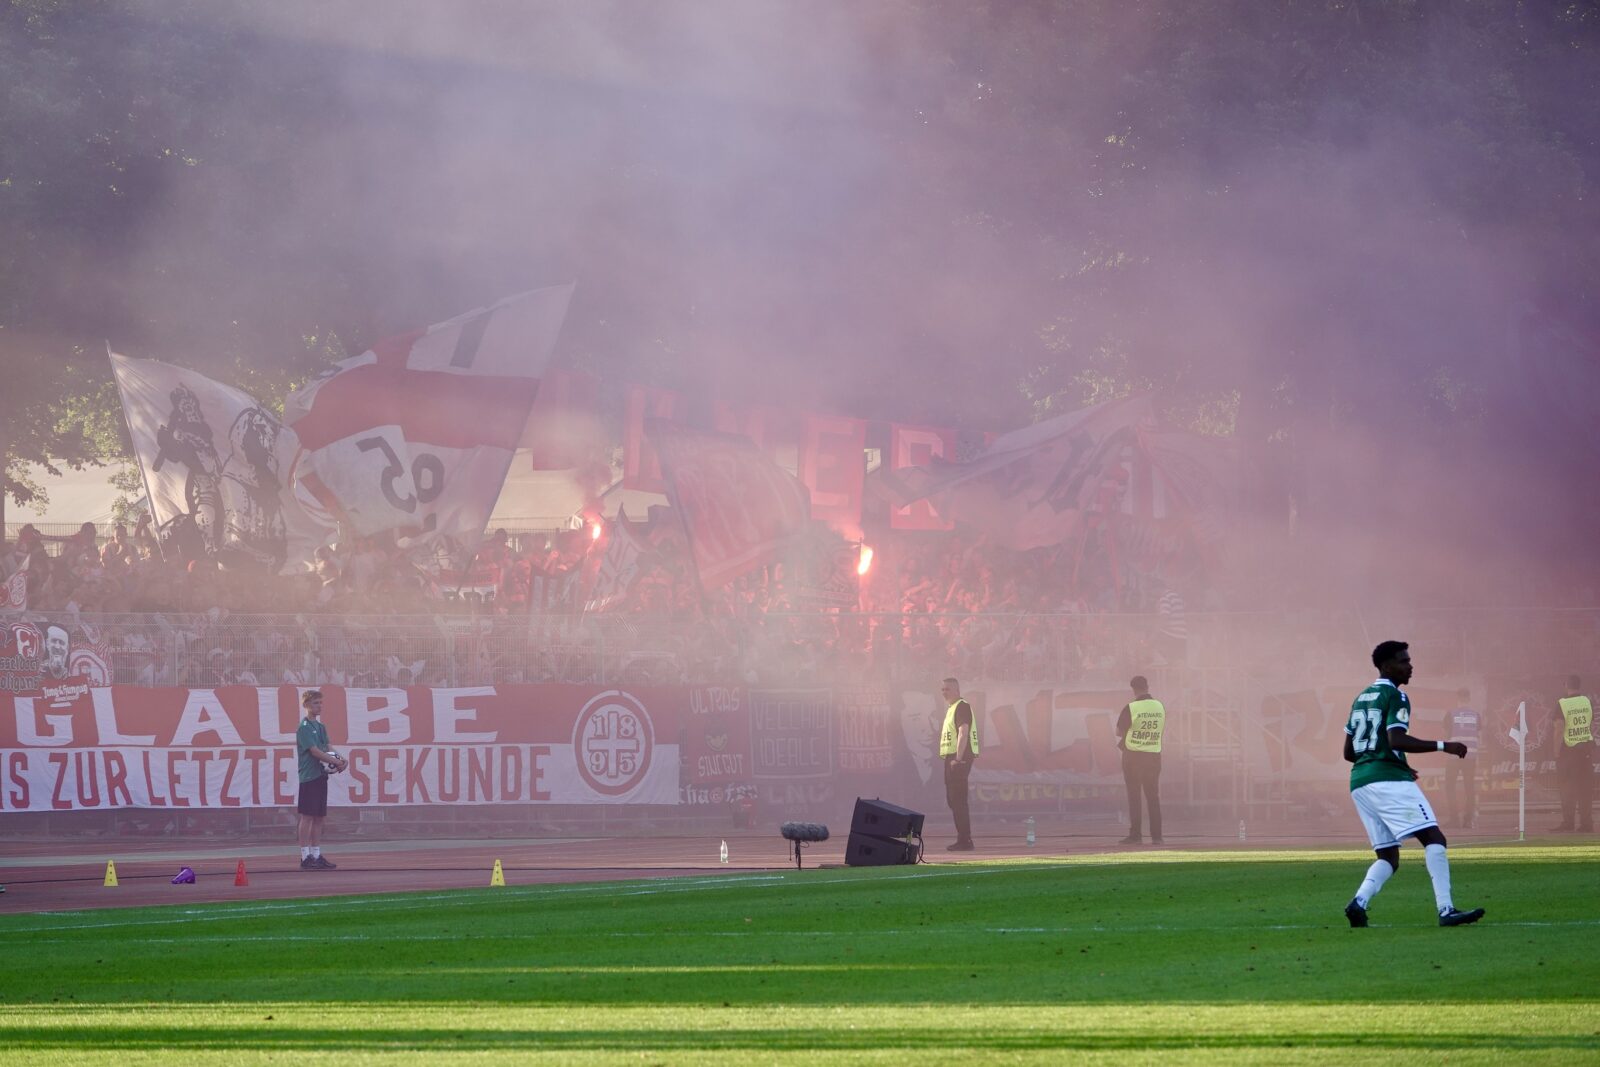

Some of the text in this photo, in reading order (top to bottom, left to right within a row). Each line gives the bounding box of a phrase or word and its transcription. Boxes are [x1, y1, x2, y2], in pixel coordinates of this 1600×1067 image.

[689, 686, 741, 715] ULTRAS
[753, 700, 828, 731] VECCHIO
[1136, 711, 1163, 719] STEWARD
[14, 684, 498, 748] GLAUBE
[1140, 720, 1159, 730] 285
[1351, 708, 1383, 754] 27
[1572, 716, 1587, 726] 063
[1132, 730, 1161, 741] EMPIRE
[759, 736, 823, 768] IDEALE
[48, 750, 134, 810] ZUR
[142, 748, 296, 808] LETZTE
[348, 745, 551, 805] SEKUNDE
